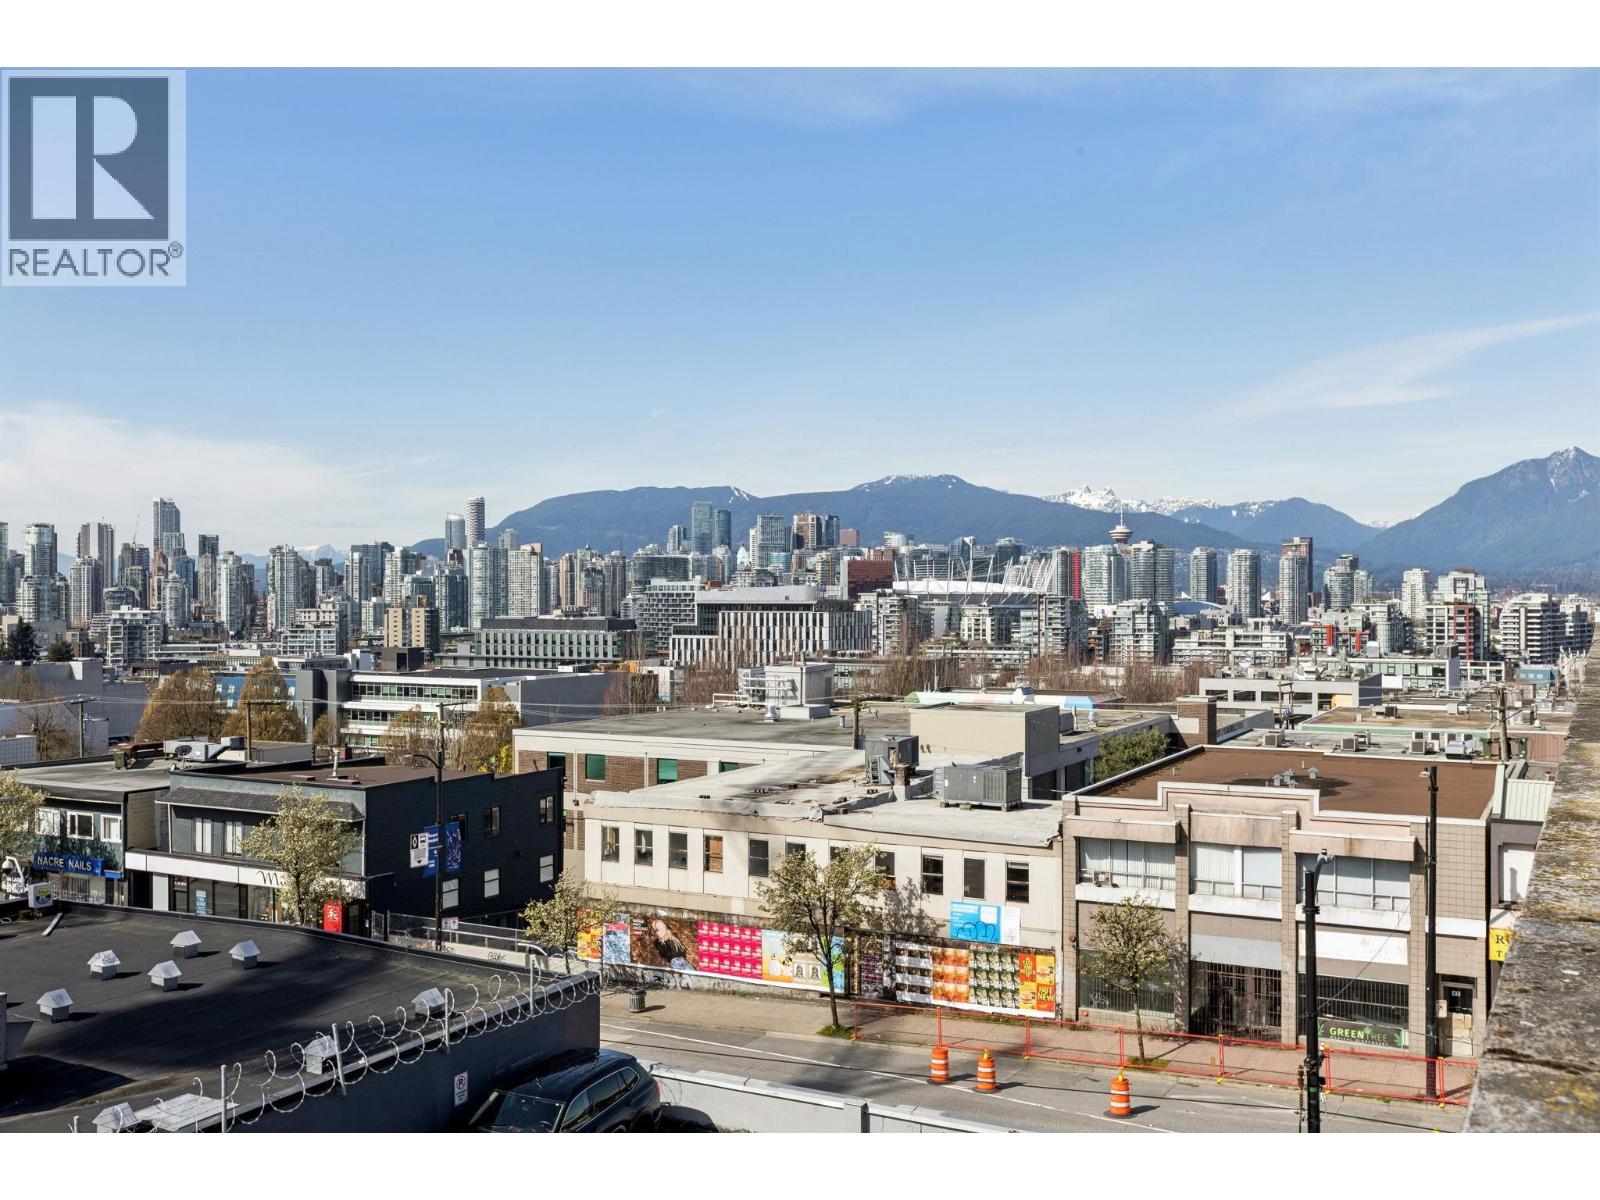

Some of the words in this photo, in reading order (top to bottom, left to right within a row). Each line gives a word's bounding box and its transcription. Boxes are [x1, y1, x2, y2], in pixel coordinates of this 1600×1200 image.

[37, 855, 64, 868] NACRE
[68, 859, 92, 872] NAILS
[1329, 1027, 1365, 1040] GREEN
